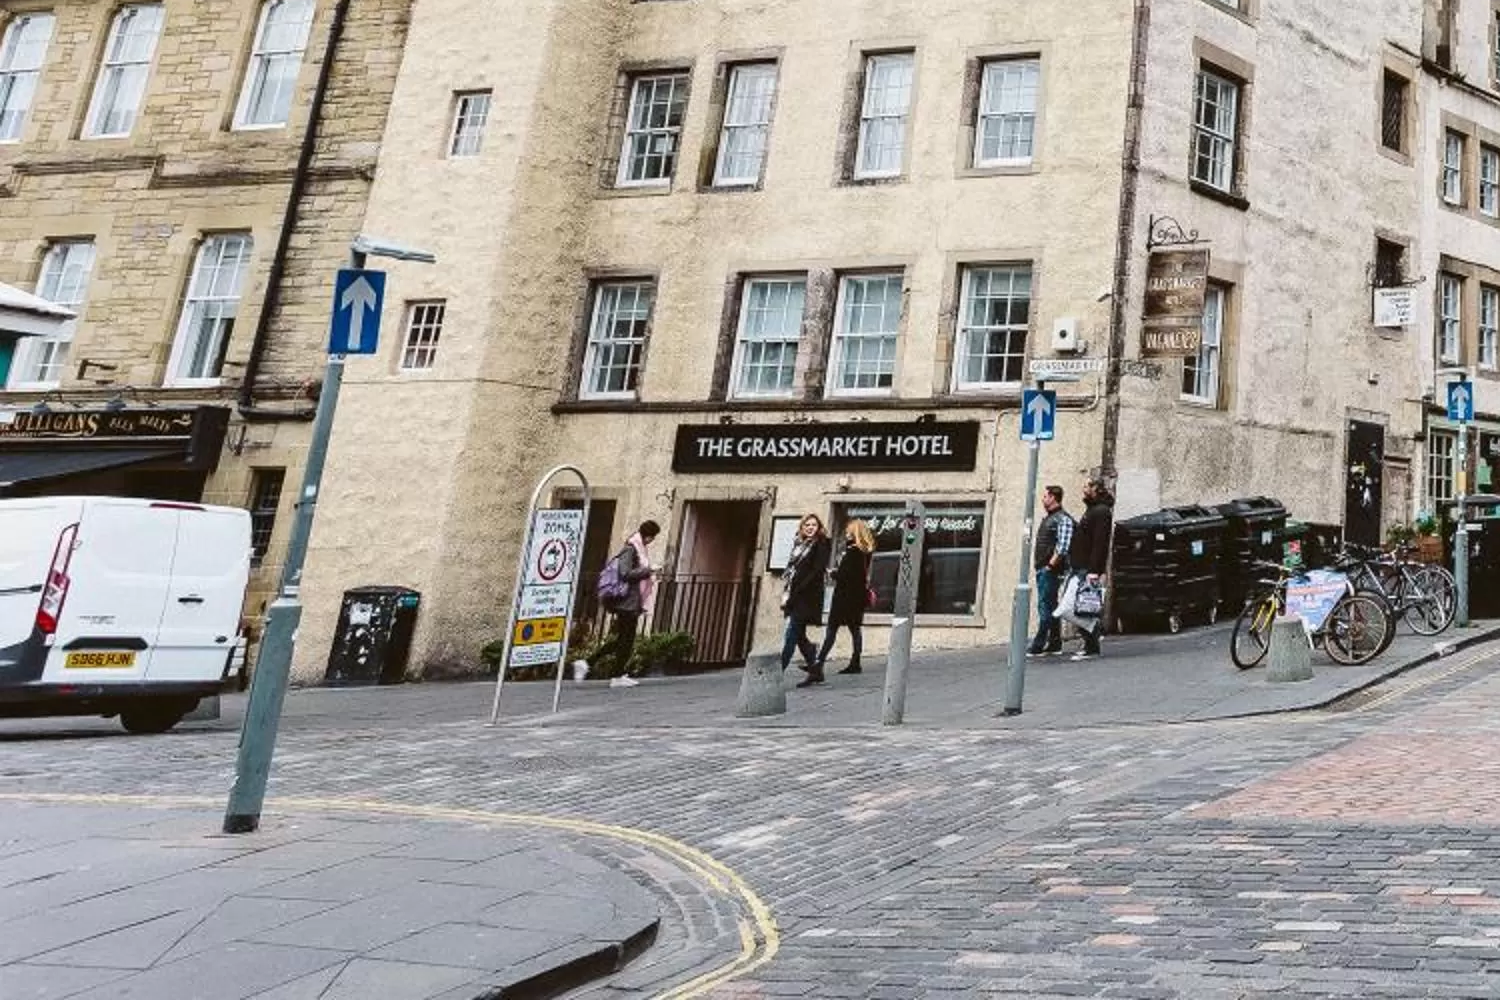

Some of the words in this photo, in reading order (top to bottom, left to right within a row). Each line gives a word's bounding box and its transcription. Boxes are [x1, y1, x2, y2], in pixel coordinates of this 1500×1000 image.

[697, 437, 733, 457] THE
[737, 436, 882, 457] GRASSMARKET
[885, 435, 952, 456] HOTEL
[544, 522, 571, 534] ZONE
